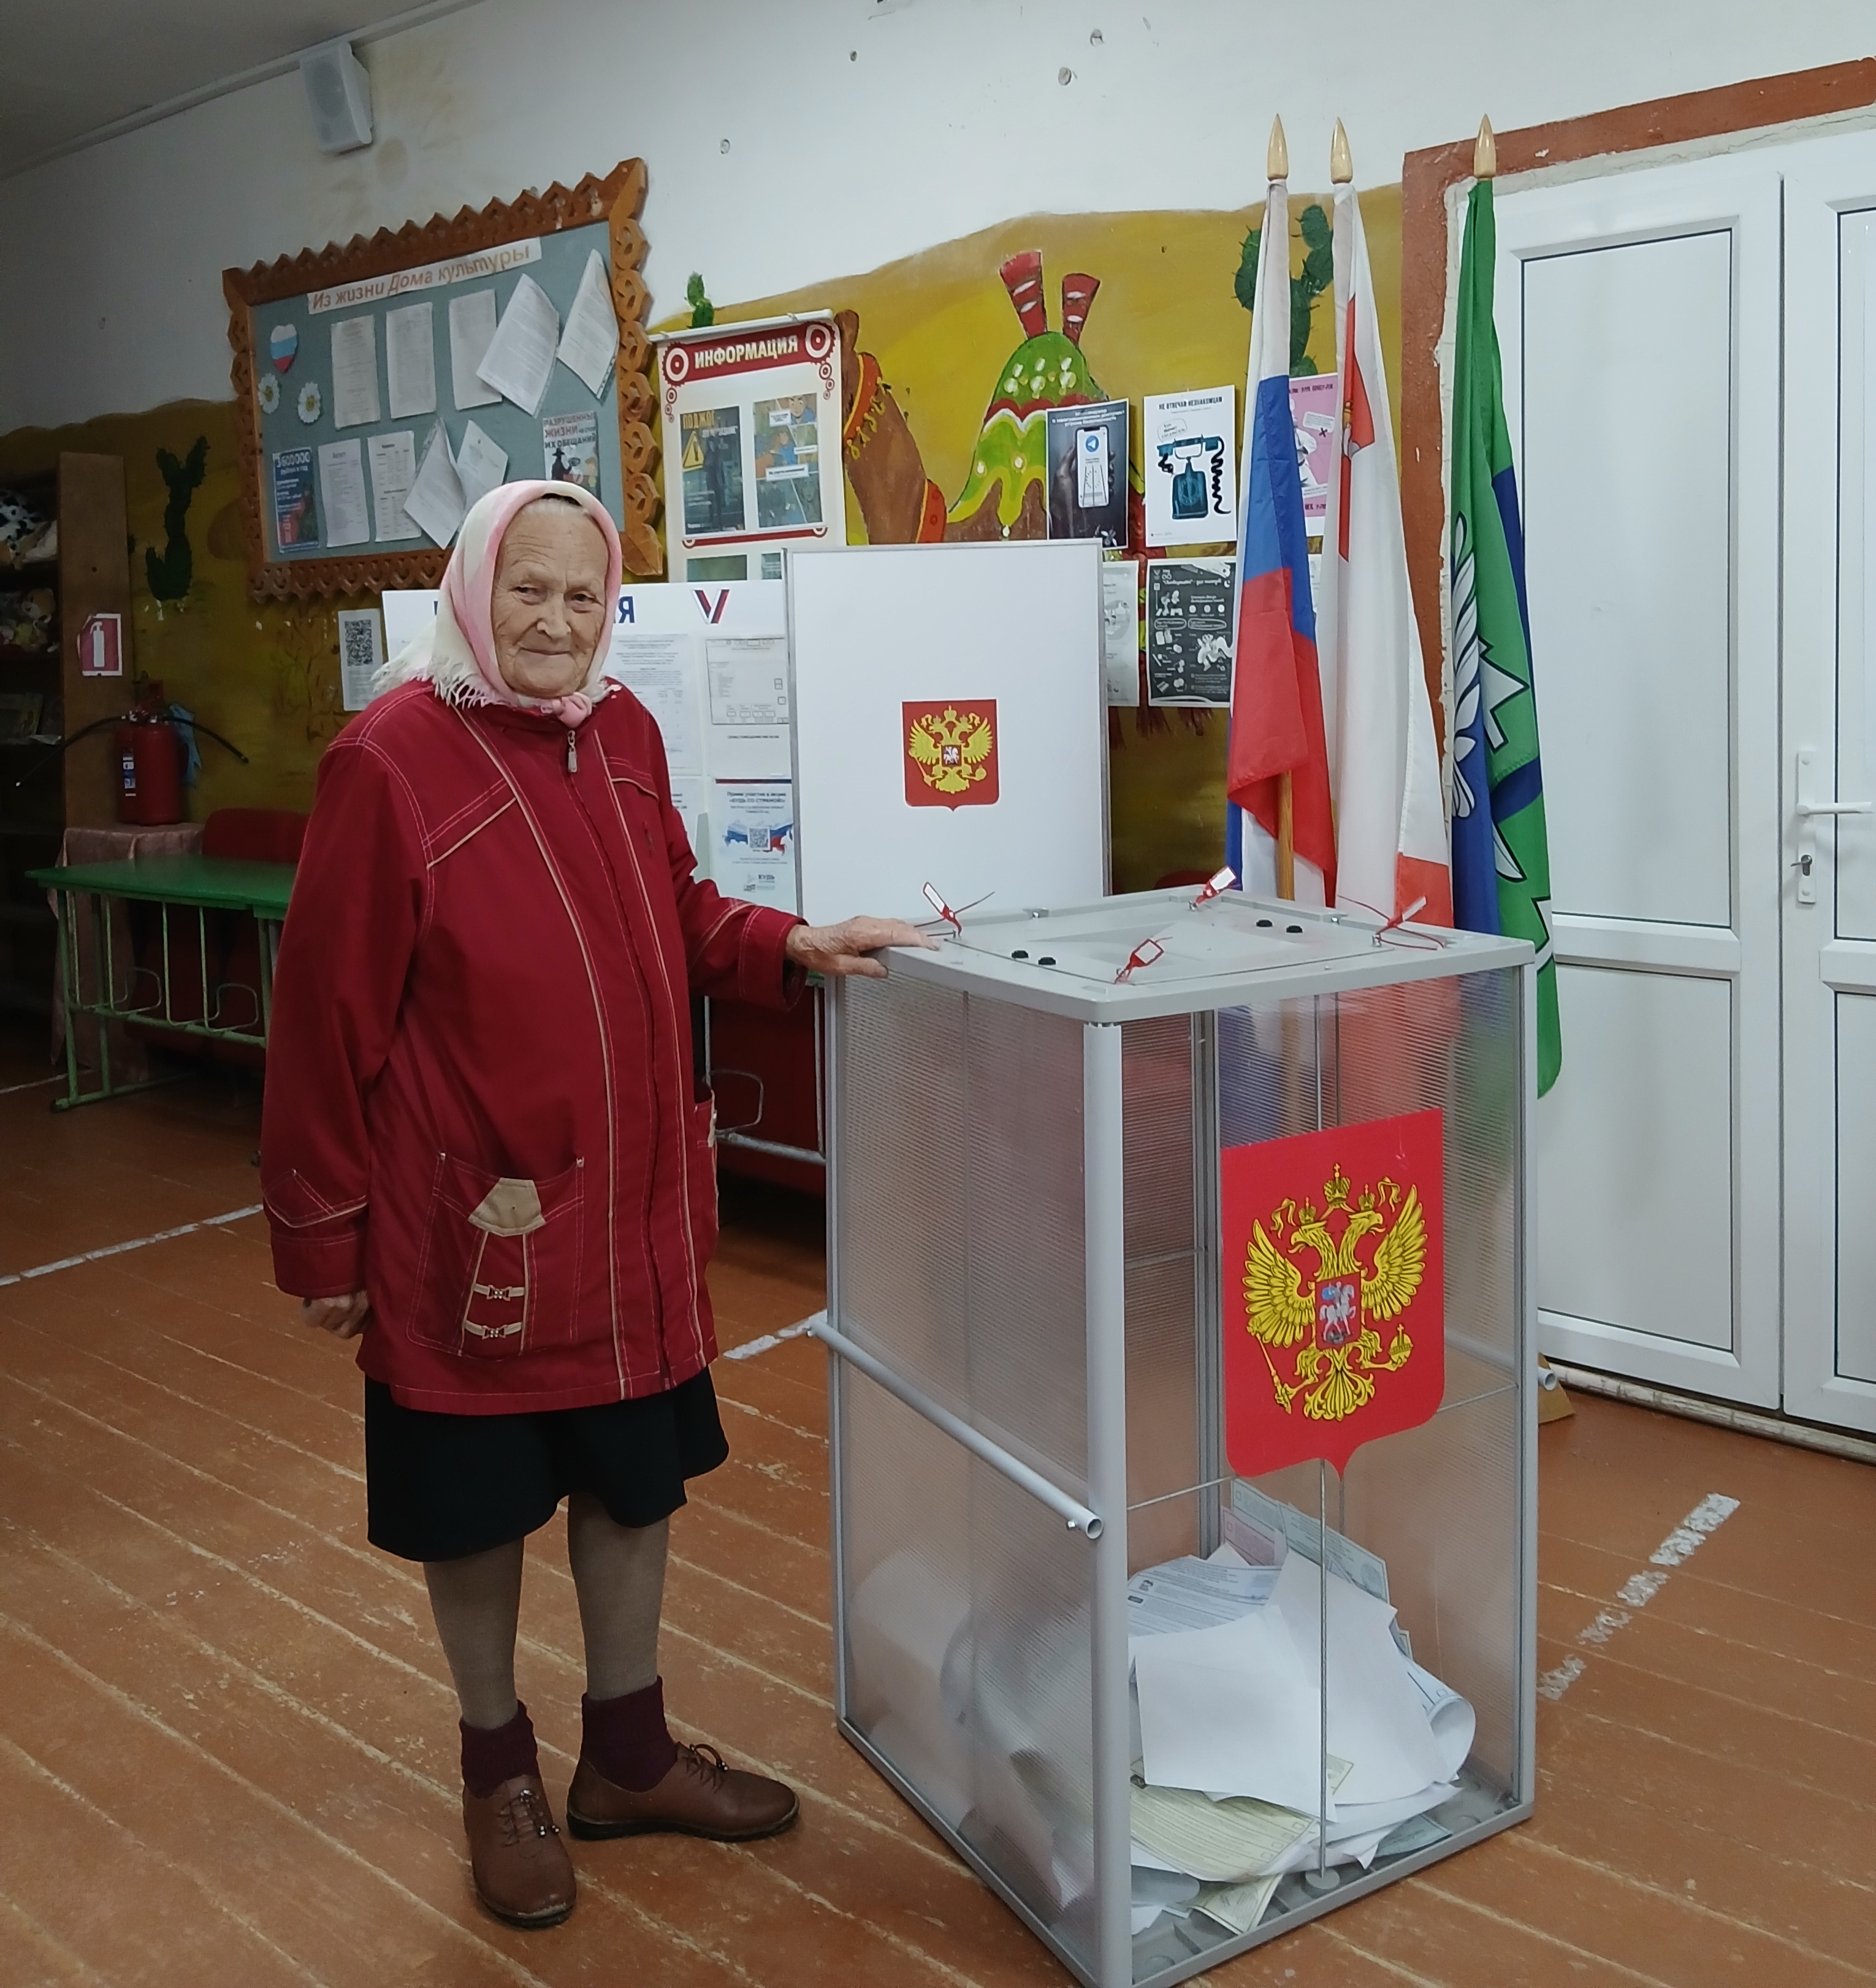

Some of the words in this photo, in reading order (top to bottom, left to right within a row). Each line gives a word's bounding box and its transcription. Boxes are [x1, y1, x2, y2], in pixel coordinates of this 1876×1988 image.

[313, 292, 332, 310] Из
[335, 282, 385, 305] жизни
[387, 270, 433, 296] Дома
[438, 245, 530, 285] культуры
[694, 335, 799, 369] ИНФОРМАЦИЯ
[544, 425, 578, 438] ЖИЗНИ
[682, 409, 715, 430] ПОДЖОГ
[614, 592, 635, 624] Я
